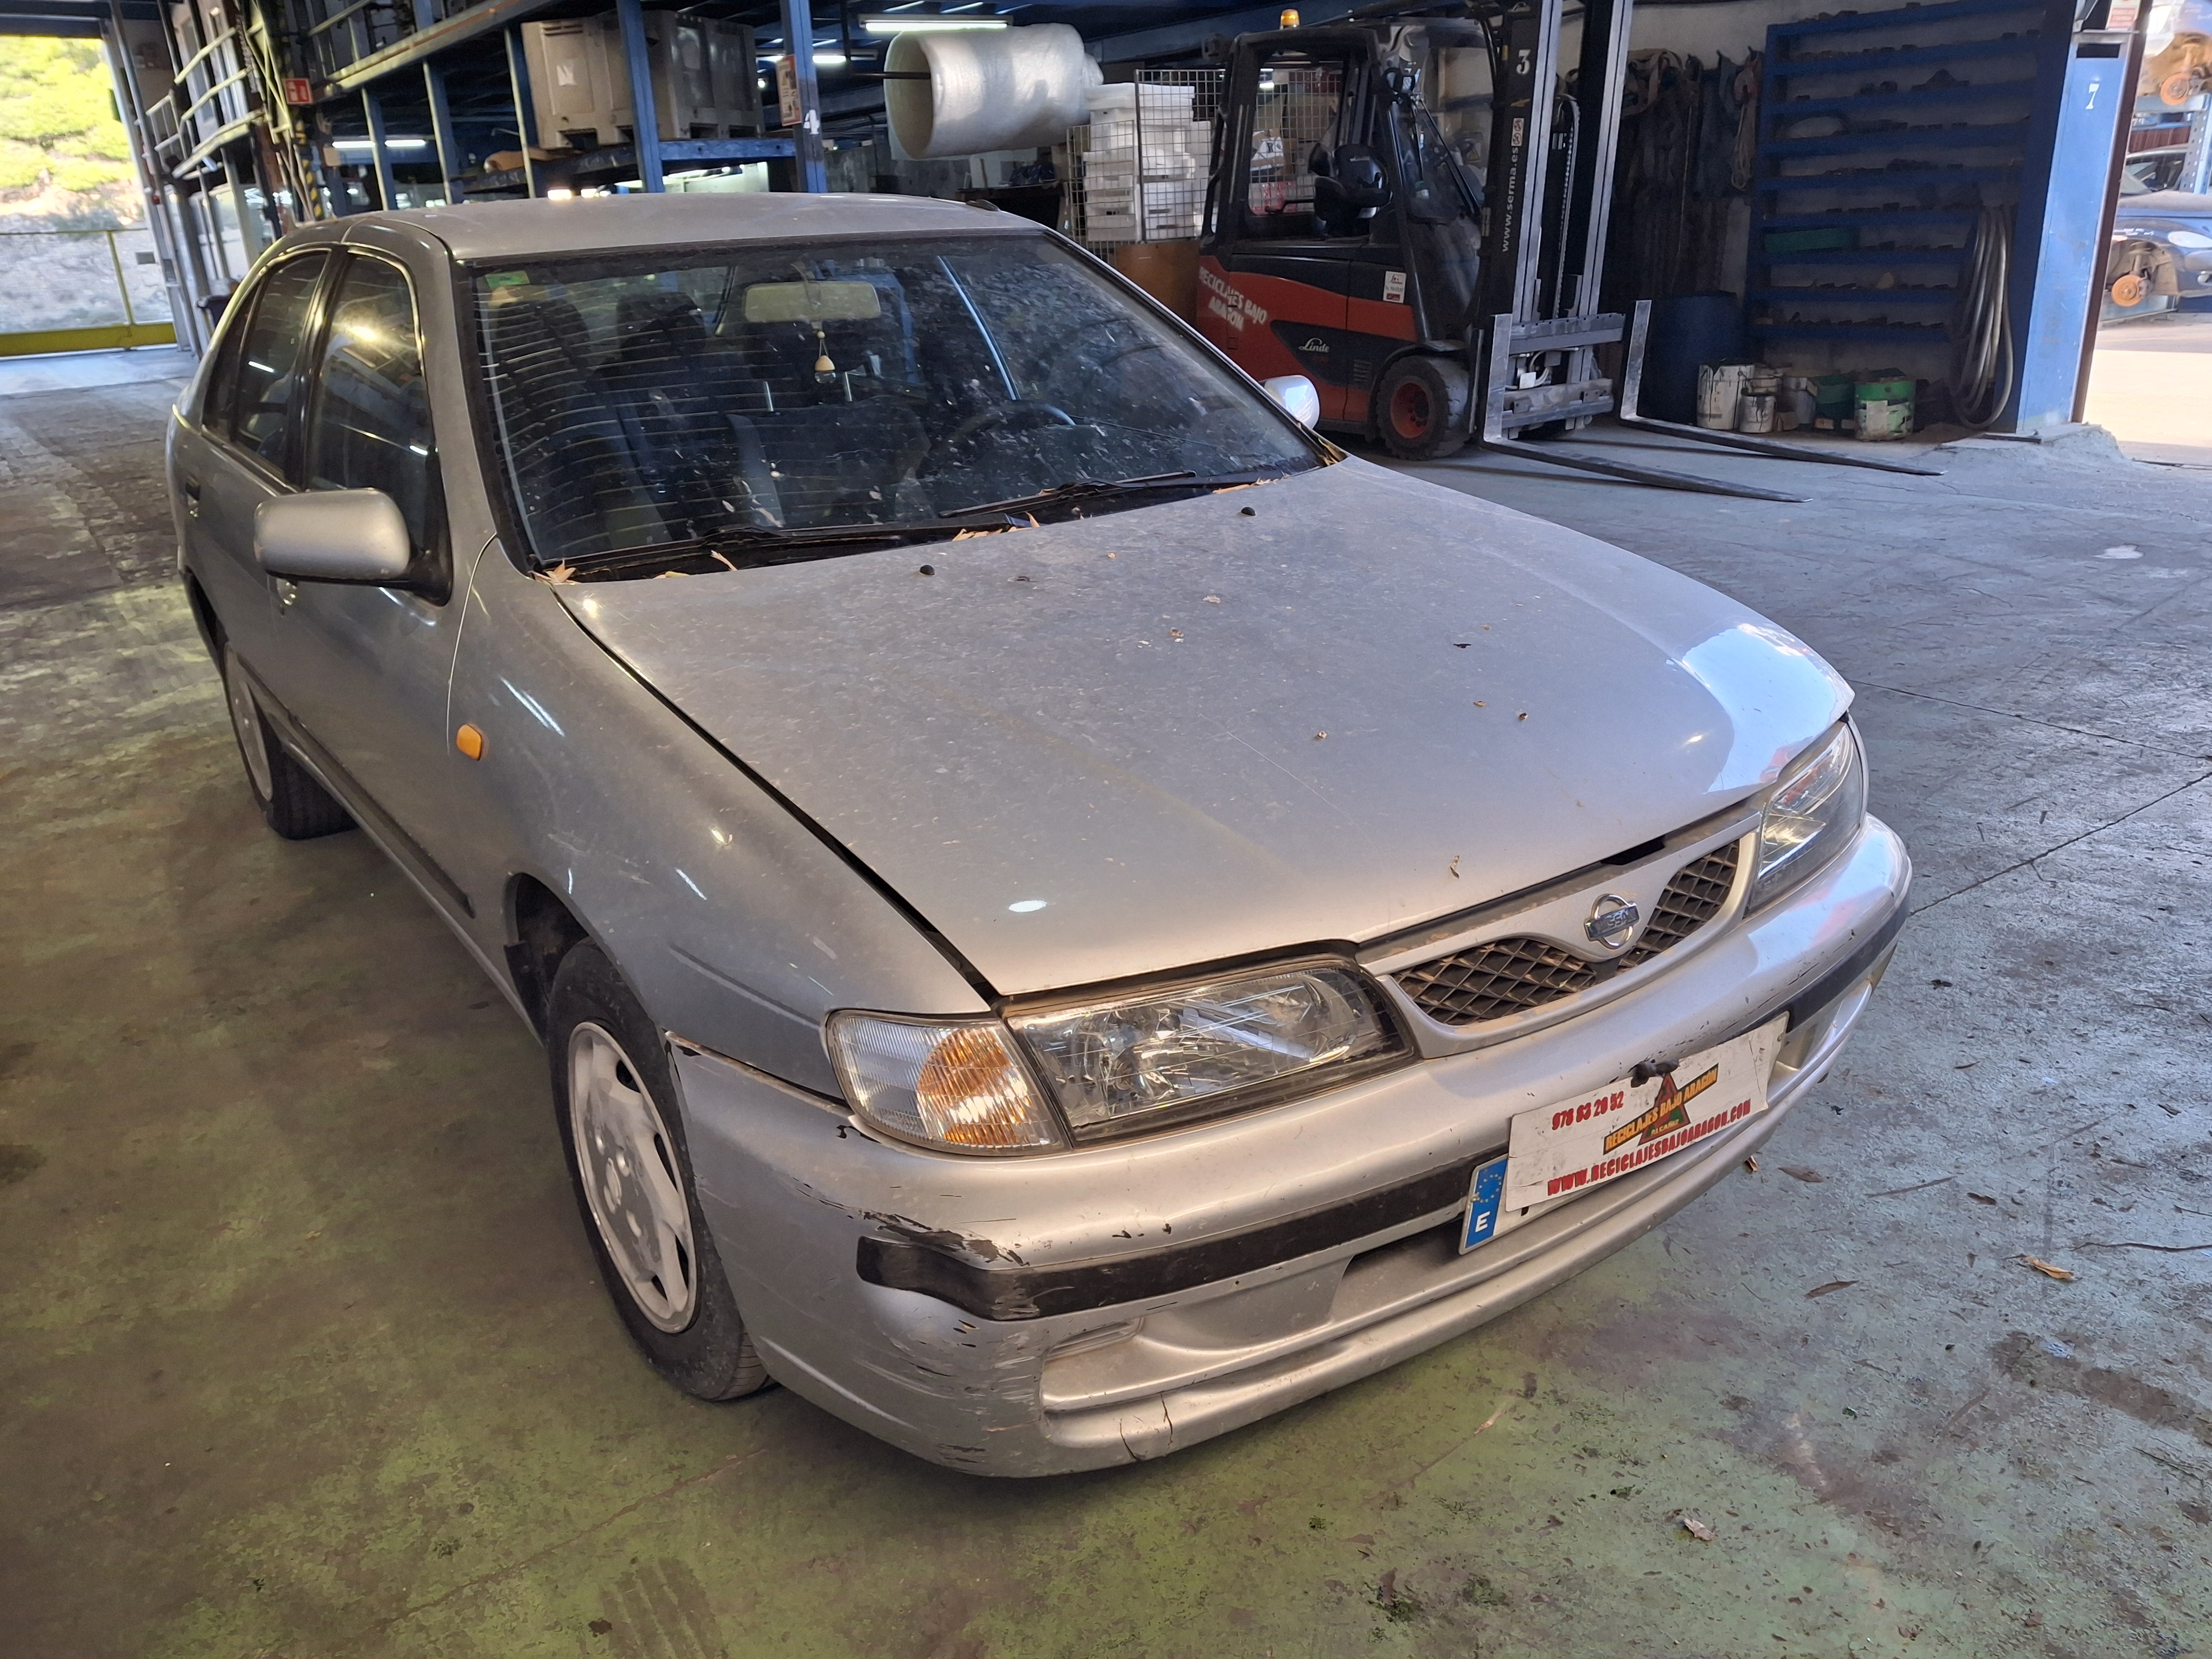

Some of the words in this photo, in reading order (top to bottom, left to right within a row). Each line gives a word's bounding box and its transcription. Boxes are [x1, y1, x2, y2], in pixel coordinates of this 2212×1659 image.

[1516, 49, 1532, 75] 3
[2086, 83, 2100, 110] 7
[803, 109, 820, 134] 4
[1502, 147, 1518, 252] www.serma.es
[1244, 299, 1268, 325] BAJO
[1298, 338, 1330, 353] Linde
[1589, 908, 1636, 937] SSAN
[1610, 1091, 1624, 1111] 52
[1605, 1107, 1659, 1150] RECICLAJES
[1660, 1091, 1682, 1118] BAJO
[1547, 1098, 1751, 1196] WWW.RECICLAJESBAJOARAGON.COM
[1475, 1211, 1490, 1233] E
